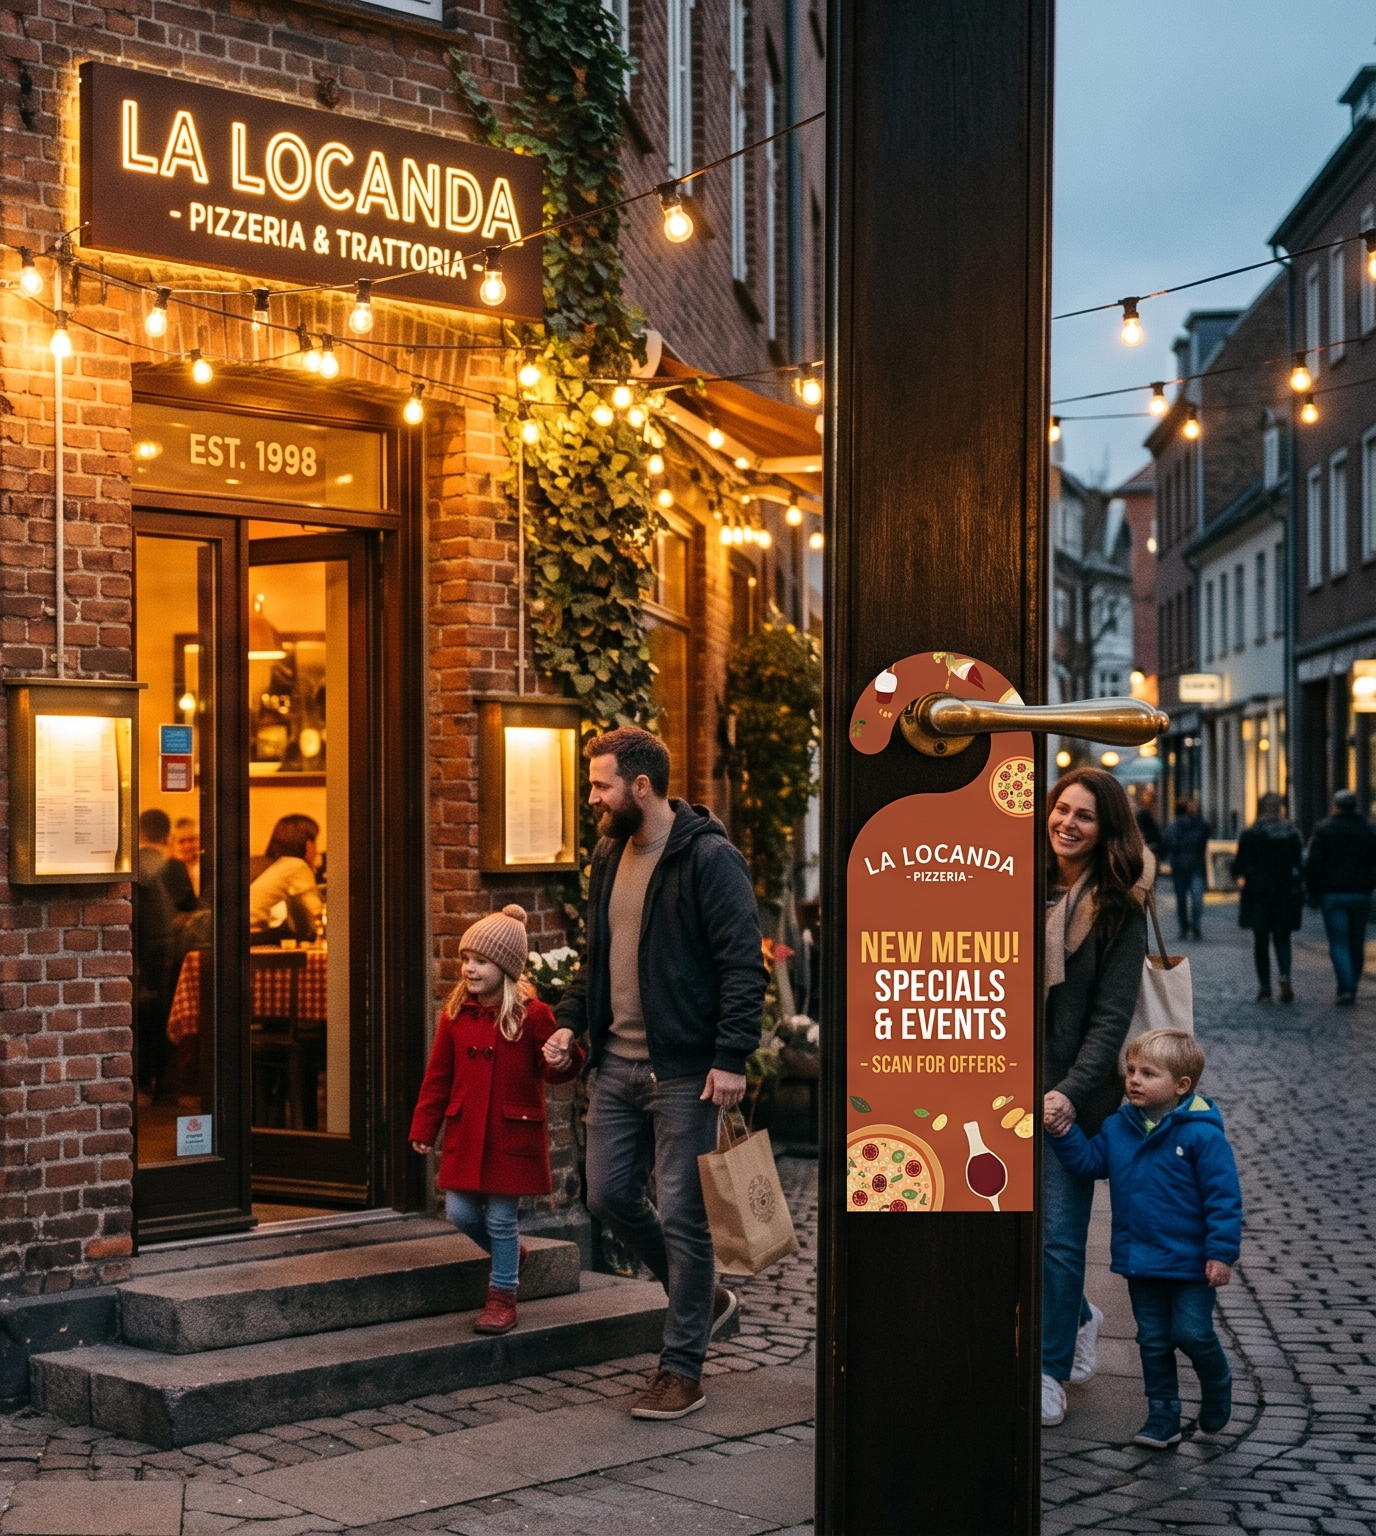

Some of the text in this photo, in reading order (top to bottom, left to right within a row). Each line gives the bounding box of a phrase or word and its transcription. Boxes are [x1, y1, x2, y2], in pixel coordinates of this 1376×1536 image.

[121, 98, 524, 247] LA LOCANDA
[188, 201, 468, 280] PIZZERIA & TRATTORIA
[189, 432, 317, 477] EST. 1998
[863, 843, 1015, 877] LA LOCANDA
[913, 871, 967, 882] PIZZERIA
[860, 931, 1020, 964] NEW MENU!
[874, 969, 1005, 1002] SPECIALS
[874, 1007, 1006, 1040] & EVENTS
[871, 1054, 1006, 1074] SCAN FOR OFFERS
